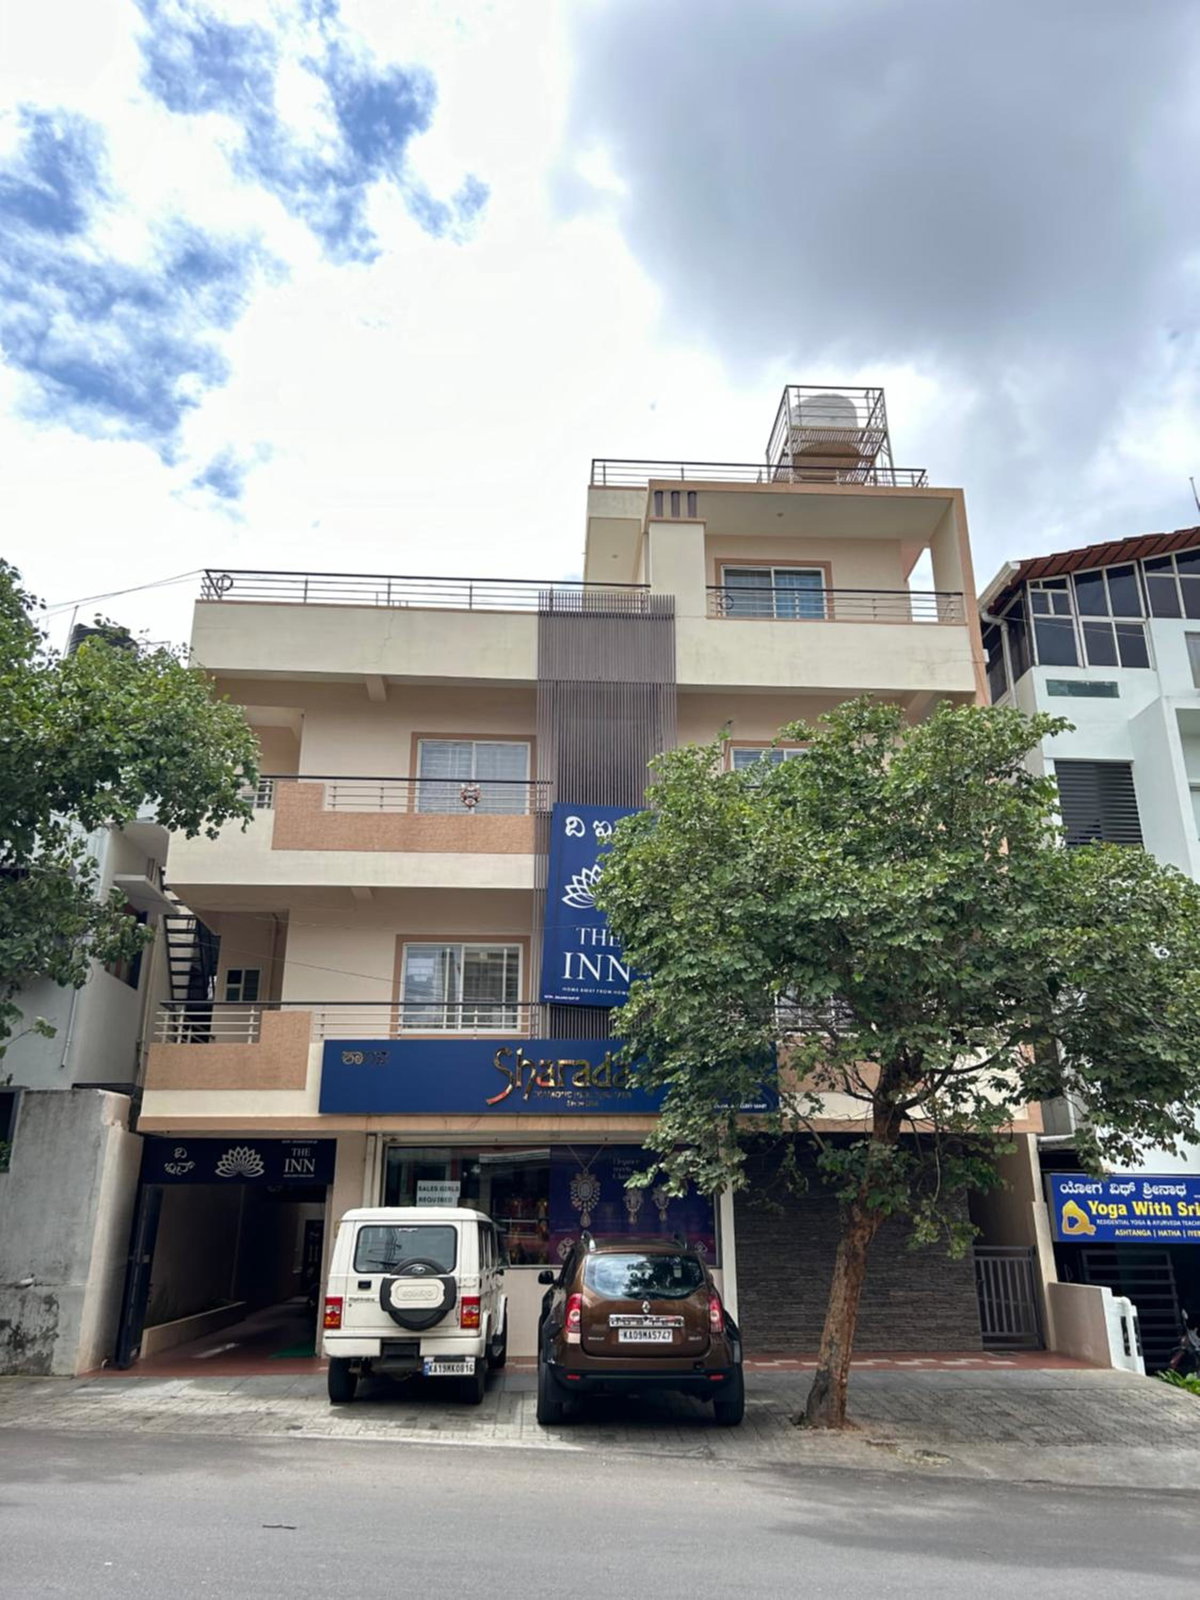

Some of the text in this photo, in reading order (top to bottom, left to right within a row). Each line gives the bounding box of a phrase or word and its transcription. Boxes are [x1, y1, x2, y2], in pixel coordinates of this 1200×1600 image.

[576, 927, 622, 948] THE
[562, 951, 630, 983] INN
[291, 1147, 312, 1157] THE
[283, 1158, 316, 1173] INN
[1060, 1180, 1103, 1195] ಯೋಗ
[418, 1196, 453, 1204] REQUIRED
[1087, 1200, 1128, 1219] Yoga
[1131, 1201, 1173, 1216] With
[1115, 1229, 1152, 1237] ASHTANGA
